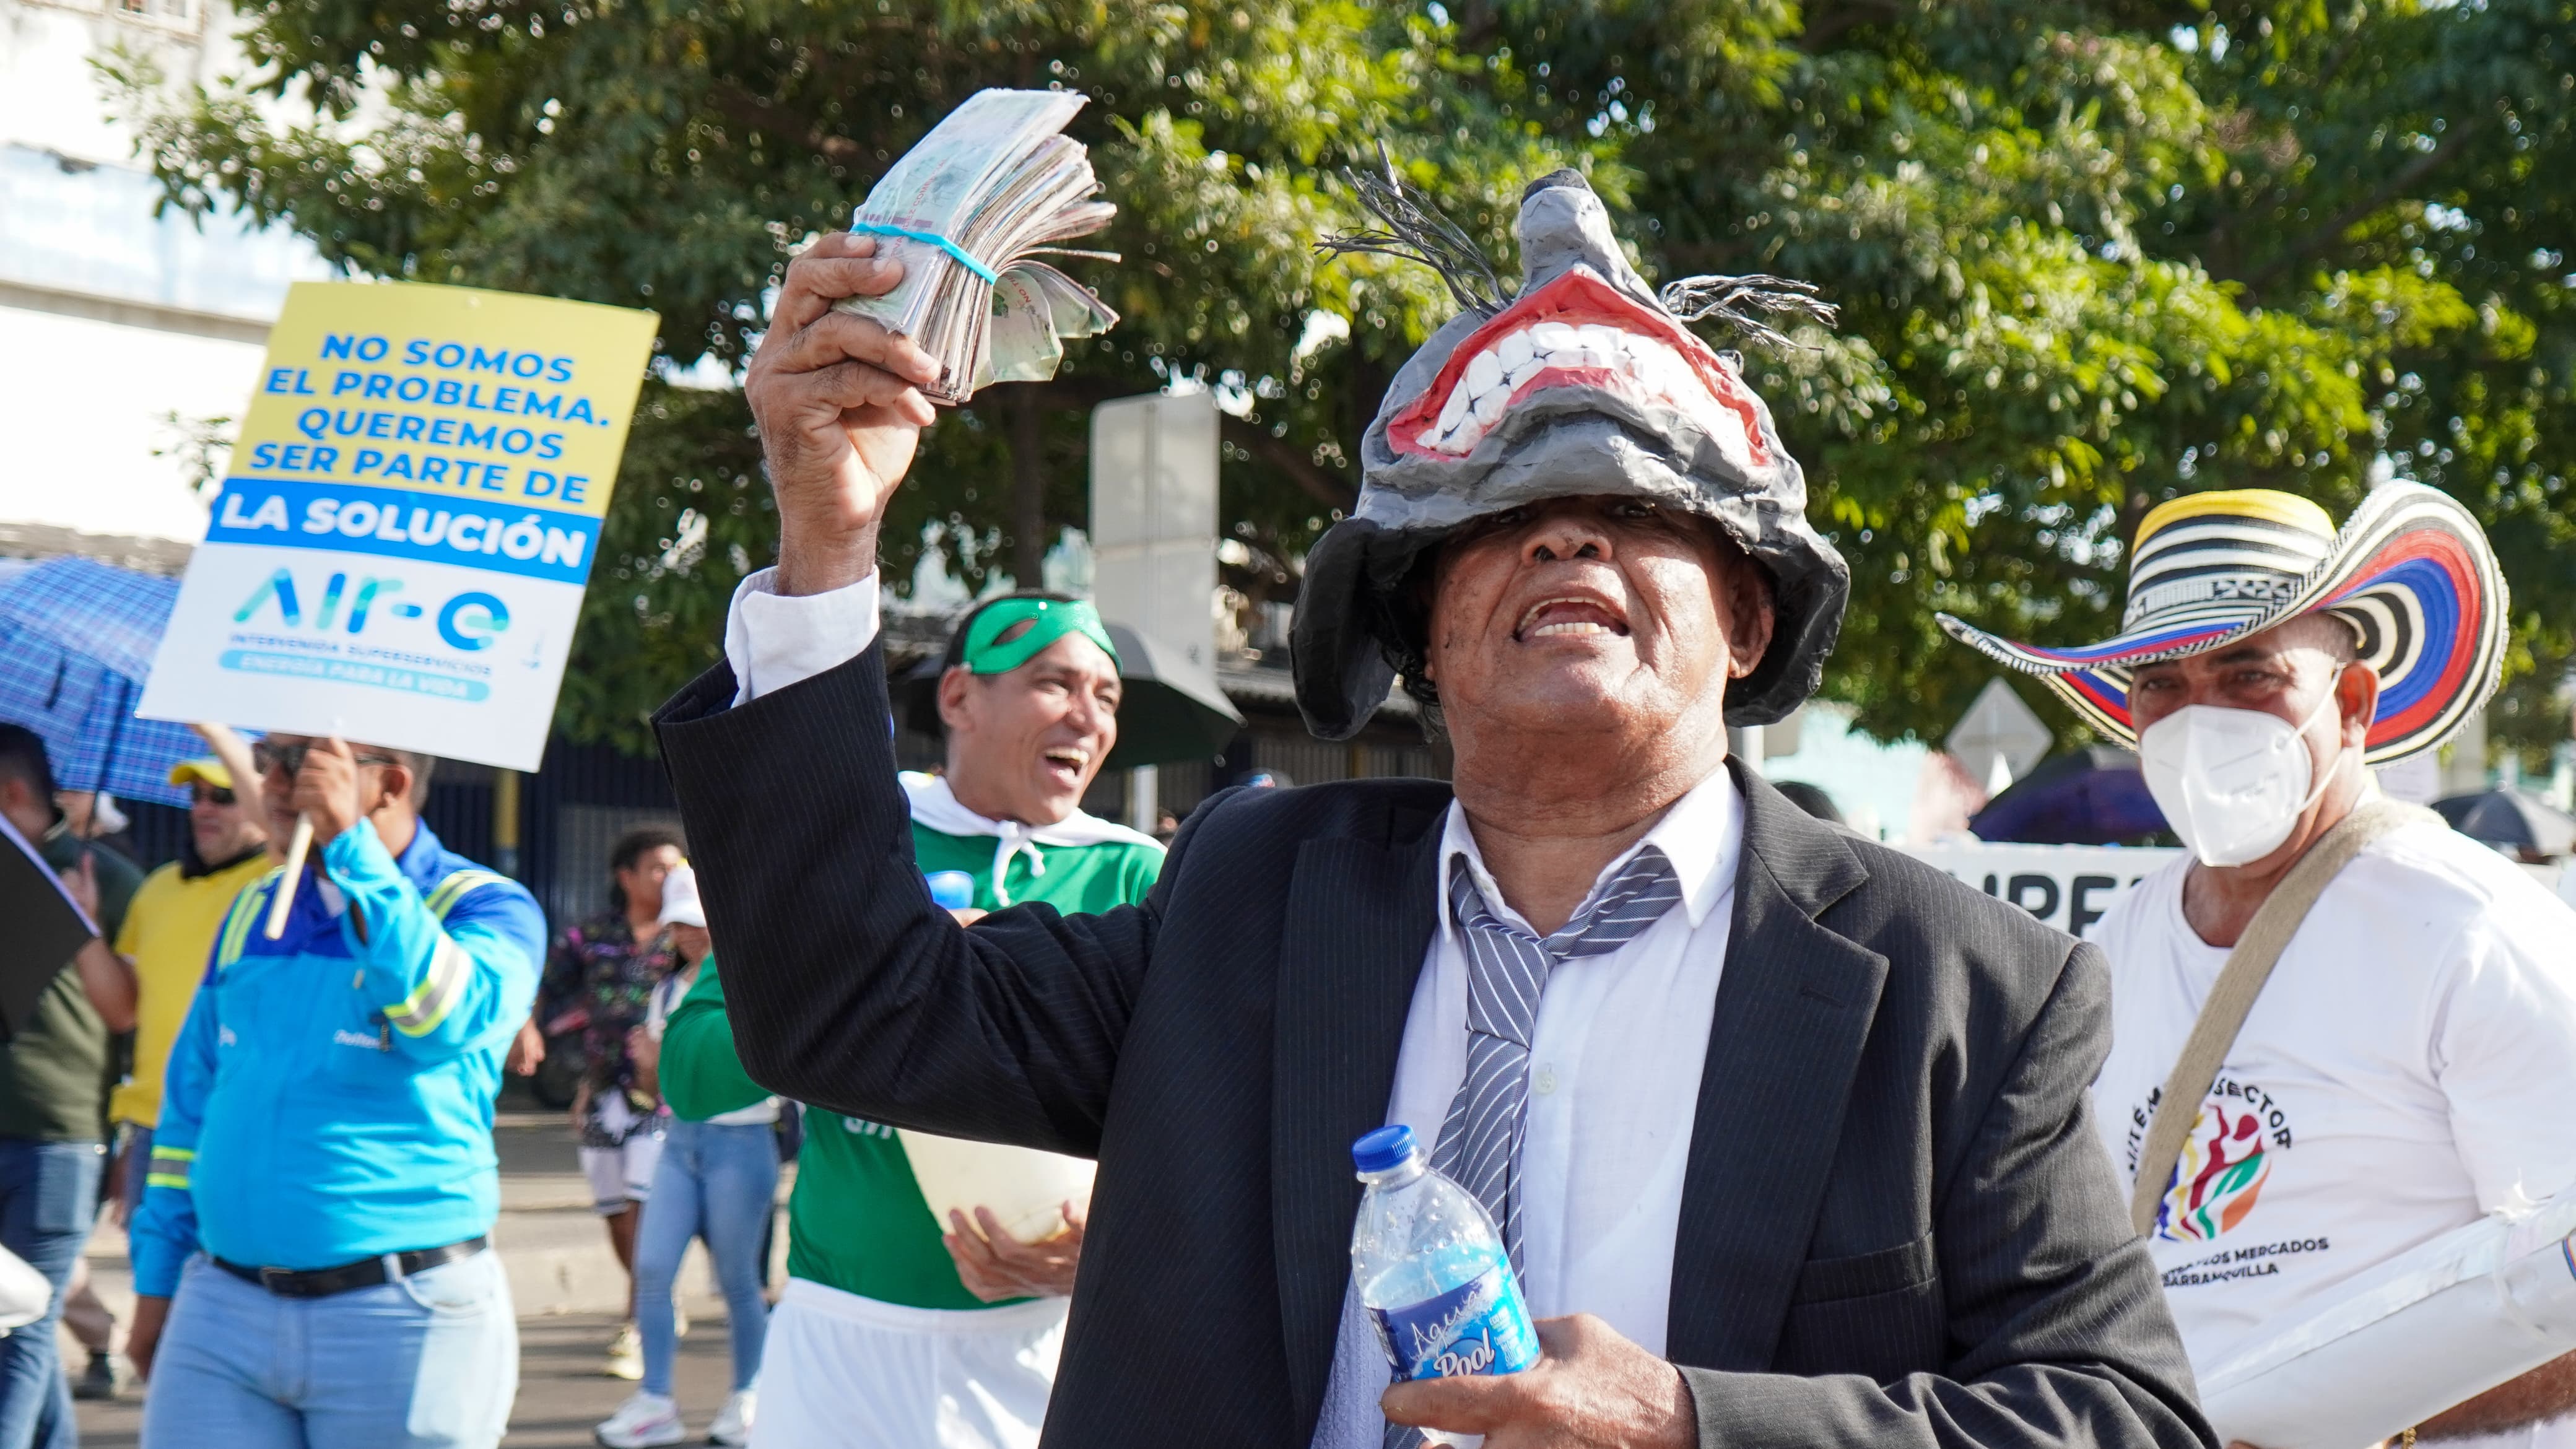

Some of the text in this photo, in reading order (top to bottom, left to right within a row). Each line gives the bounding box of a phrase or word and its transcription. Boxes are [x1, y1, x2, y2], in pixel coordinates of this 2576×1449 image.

[321, 334, 573, 383] NO SOMOS
[266, 368, 609, 426] EL PROBLEMA.
[298, 408, 563, 459] QUEREMOS
[251, 443, 589, 504] SER PARTE DE
[220, 494, 586, 568] LA SOLUCIÓN
[2234, 1237, 2330, 1261] MERCADOS
[1411, 1290, 1477, 1359] Agua
[1433, 1327, 1495, 1377] Pool
